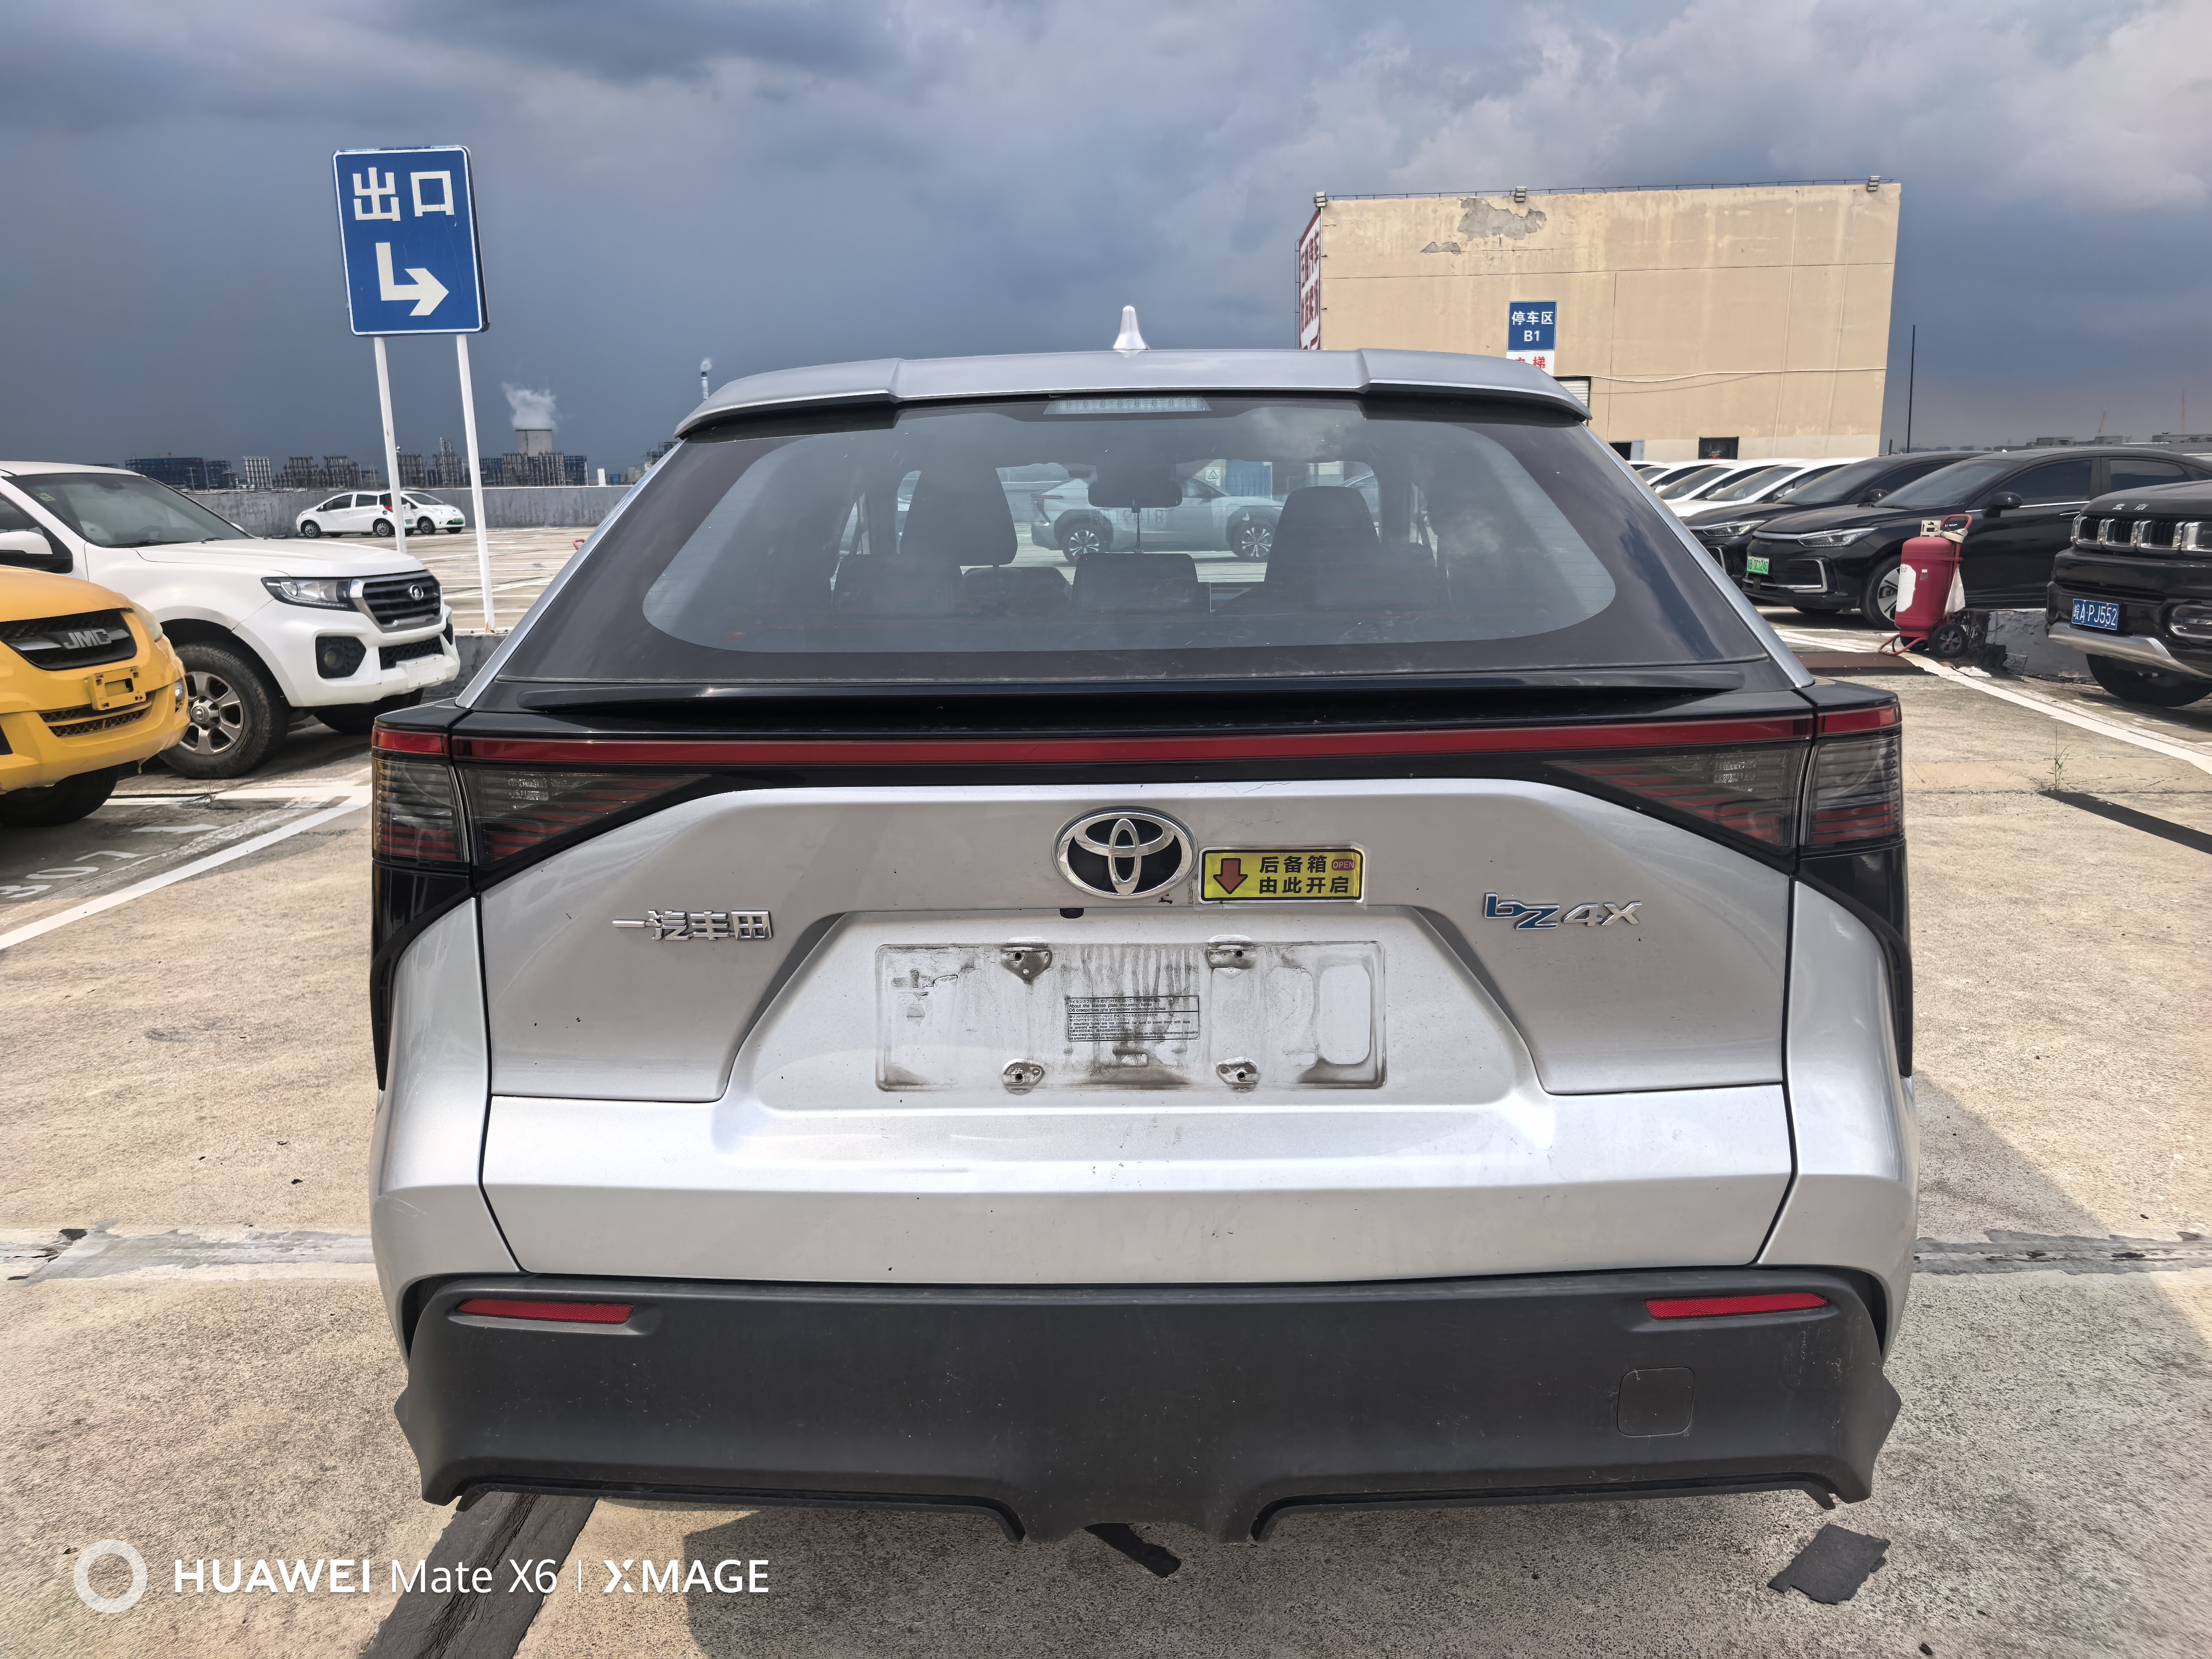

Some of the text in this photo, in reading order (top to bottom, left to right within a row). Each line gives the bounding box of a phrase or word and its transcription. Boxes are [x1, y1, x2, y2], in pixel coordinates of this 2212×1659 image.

[353, 167, 455, 221] 出口
[1512, 311, 1554, 325] 停车区
[1524, 330, 1540, 342] B1
[63, 629, 112, 649] JMC
[1259, 855, 1354, 873] 后备箱 OPEN
[1259, 876, 1349, 894] 由此开启
[612, 910, 773, 940] 一汽丰田
